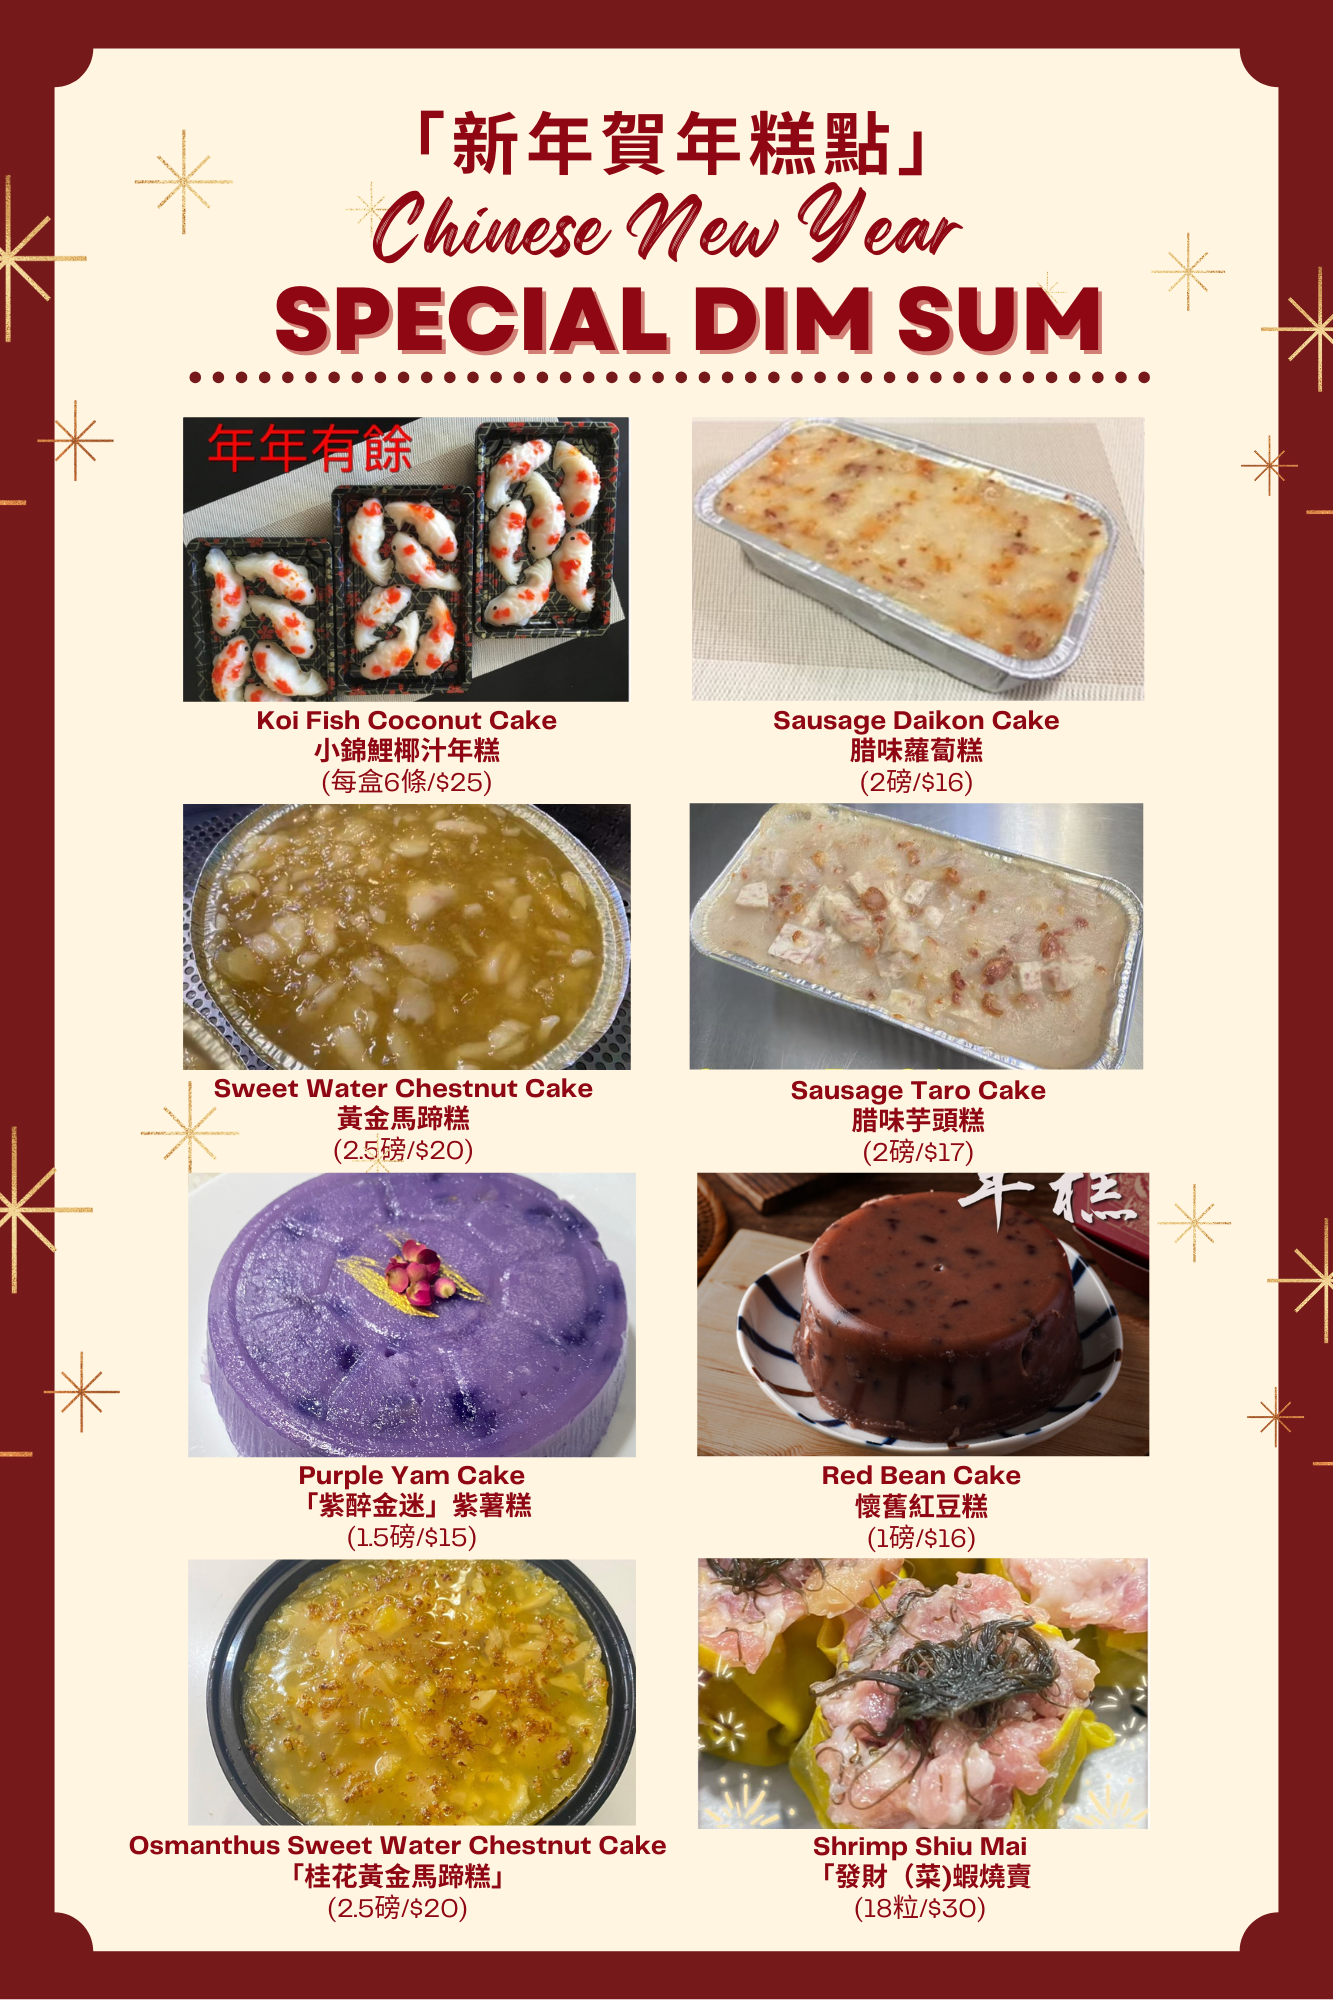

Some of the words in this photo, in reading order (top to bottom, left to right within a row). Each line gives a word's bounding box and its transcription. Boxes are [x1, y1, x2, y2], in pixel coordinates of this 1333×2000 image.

[421, 111, 922, 175] 「新年賀年糕點」
[373, 191, 612, 263] Chinese
[627, 193, 779, 262] New
[798, 182, 963, 263] Year
[276, 286, 670, 355] SPECIAL
[696, 286, 873, 355] DIM
[899, 286, 1103, 355] SUM
[208, 424, 412, 473] 年年有餘
[258, 711, 298, 729] Koi
[307, 710, 359, 729] Fish
[369, 711, 481, 729] Coconut
[490, 710, 556, 729] Cake
[774, 711, 885, 735] Sausage
[895, 710, 983, 729] Daikon
[993, 710, 1059, 729] Cake
[314, 737, 499, 762] 小錦鯉椰汁年糕
[851, 737, 982, 762] 腊味蘿蔔糕
[323, 769, 491, 796] (每盒6條/$25)
[861, 769, 972, 796] (2磅/$16)
[215, 1079, 298, 1097] Sweet
[307, 1079, 387, 1097] Water
[396, 1078, 517, 1097] Chestnut
[526, 1078, 592, 1097] Cake
[792, 1081, 903, 1105] Sausage
[911, 1081, 970, 1099] Taro
[979, 1080, 1045, 1099] Cake
[338, 1105, 469, 1130] 黃金馬蹄糕
[852, 1107, 984, 1132] 腊味芋頭糕
[335, 1137, 472, 1164] (2.5磅/$20)
[864, 1139, 972, 1166] (2磅/$17)
[300, 1465, 383, 1489] Purple
[392, 1466, 449, 1484] Yam
[458, 1465, 524, 1484] Cake
[823, 1465, 872, 1484] Red
[882, 1466, 945, 1484] Bean
[954, 1465, 1020, 1484] Cake
[855, 1493, 987, 1518] 懷舊紅豆糕
[348, 1524, 475, 1551] (1.5磅/$15)
[869, 1525, 974, 1552] (1磅/$16)
[130, 1835, 279, 1854] Osmanthus
[288, 1836, 372, 1854] Sweet
[380, 1836, 461, 1854] Water
[470, 1835, 591, 1854] Chestnut
[600, 1835, 666, 1854] Cake
[814, 1836, 907, 1860] Shrimp
[916, 1836, 971, 1855] Shiu
[981, 1837, 1026, 1855] Mai
[295, 1863, 501, 1888] 「桂花黃金馬蹄糕」
[329, 1895, 466, 1922] (2.5磅/$20)
[856, 1895, 984, 1922] (18粒/$30)
